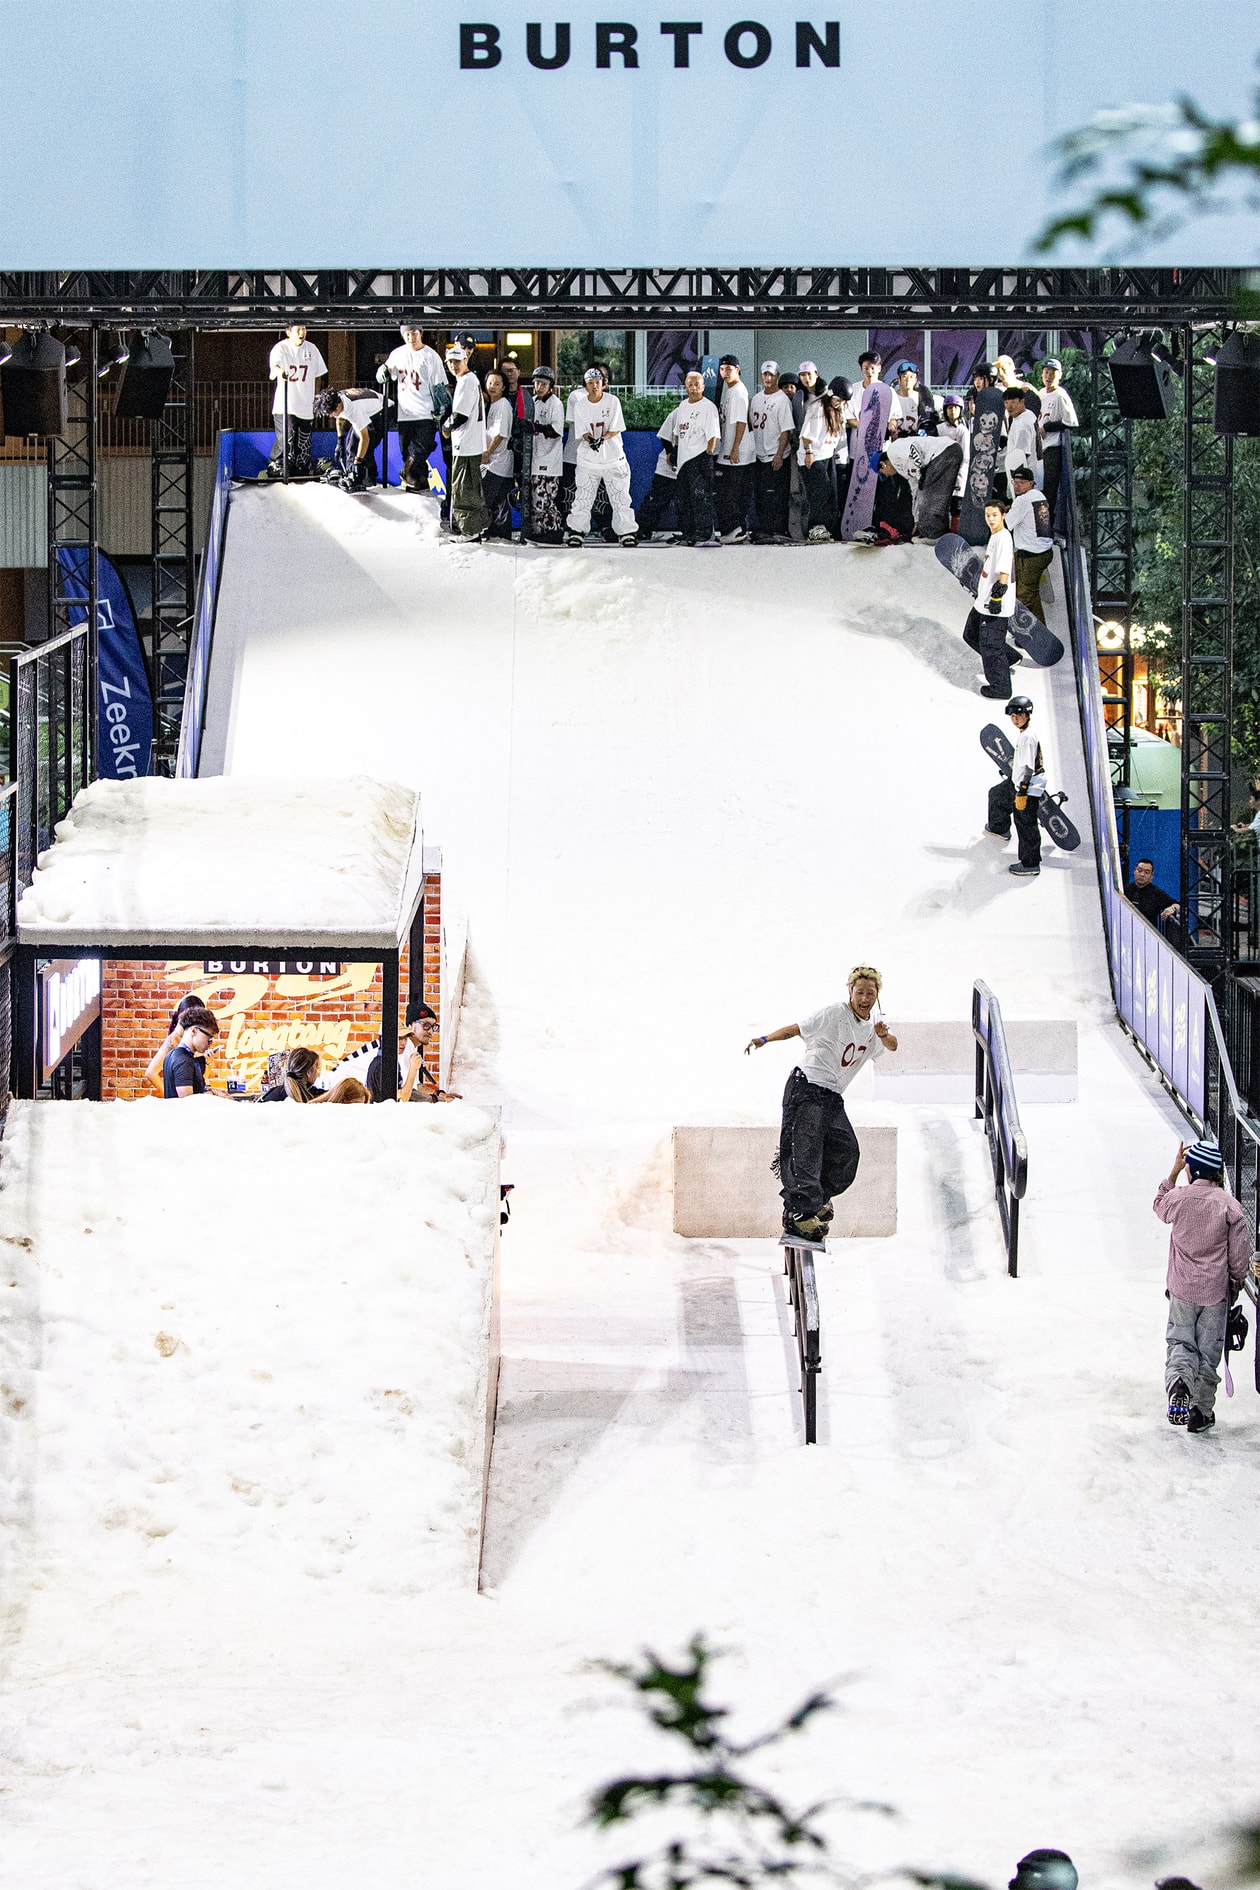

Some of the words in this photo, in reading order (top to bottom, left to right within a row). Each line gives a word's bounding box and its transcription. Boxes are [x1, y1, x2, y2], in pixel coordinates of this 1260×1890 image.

[459, 20, 841, 70] BURTON
[288, 364, 309, 383] 27
[752, 411, 768, 430] 28
[590, 421, 605, 440] 17
[841, 1042, 867, 1067] 07
